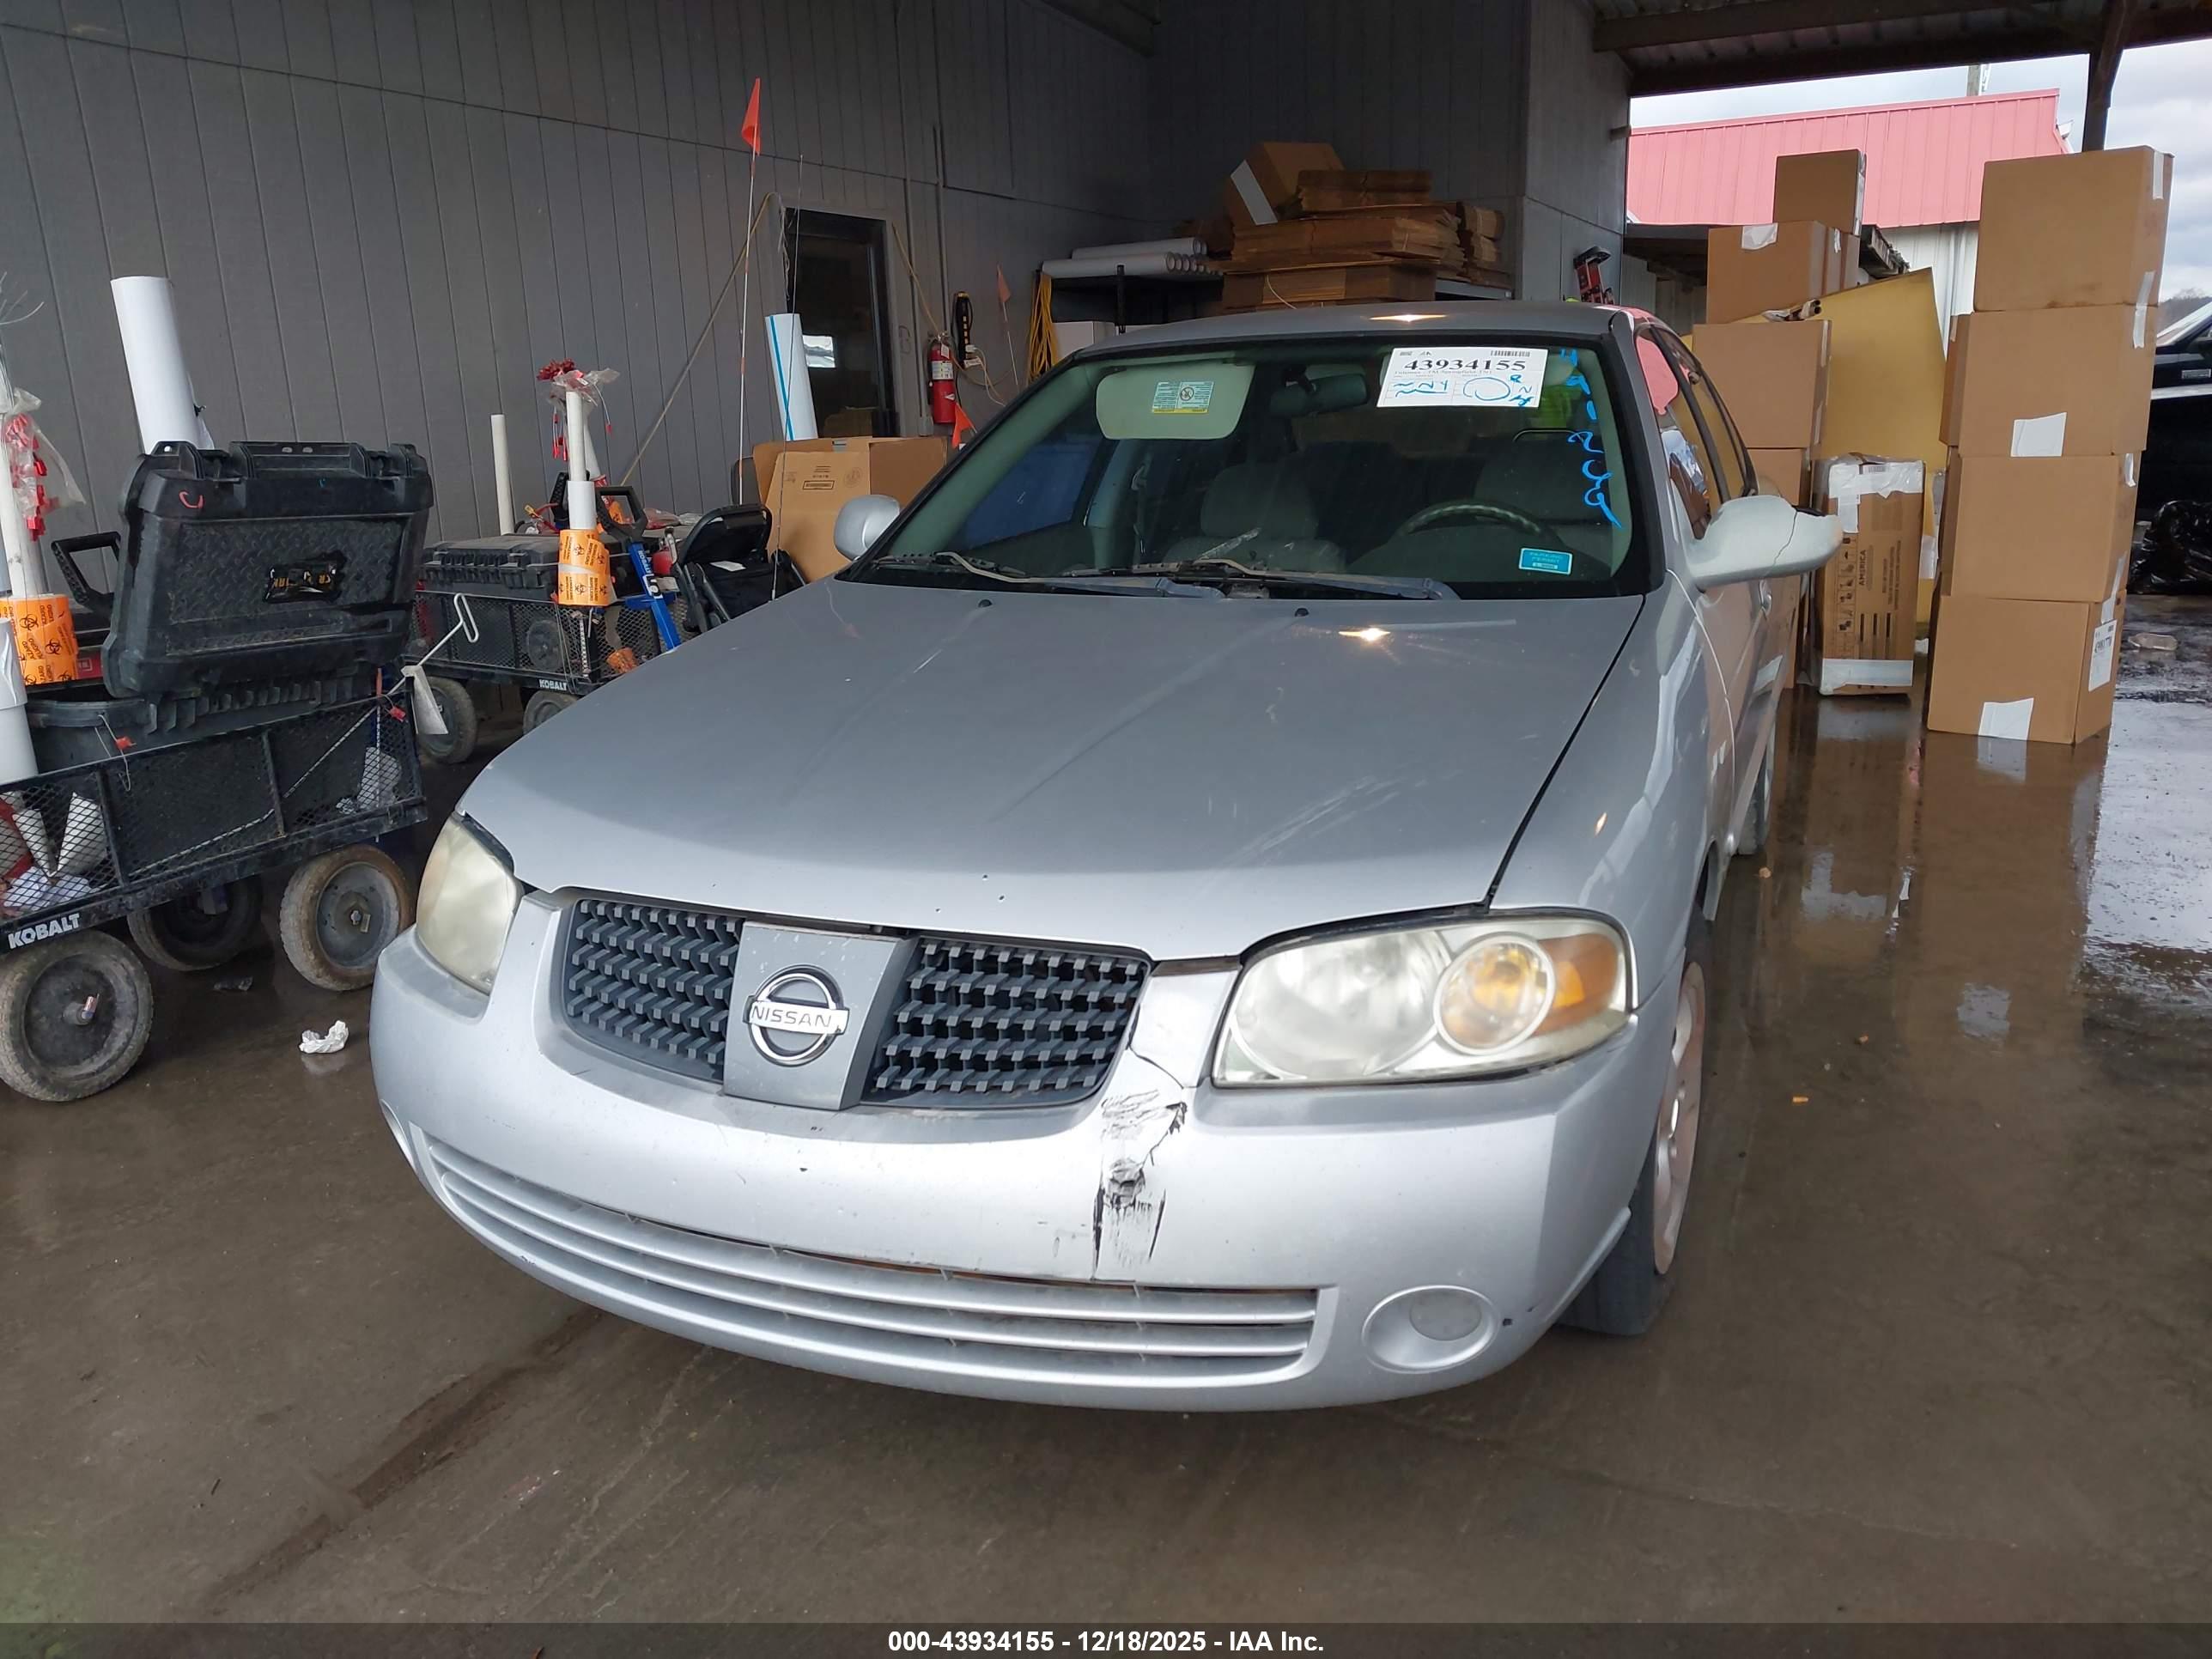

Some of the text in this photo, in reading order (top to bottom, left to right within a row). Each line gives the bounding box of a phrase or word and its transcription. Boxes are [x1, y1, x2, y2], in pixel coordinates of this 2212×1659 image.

[1404, 359, 1526, 371] 43934155
[638, 550, 652, 574] KOBALT
[1858, 549, 1867, 586] AMERICA
[539, 678, 568, 691] KOBALT
[8, 913, 80, 950] KOBALT
[751, 1006, 831, 1028] NISSAN
